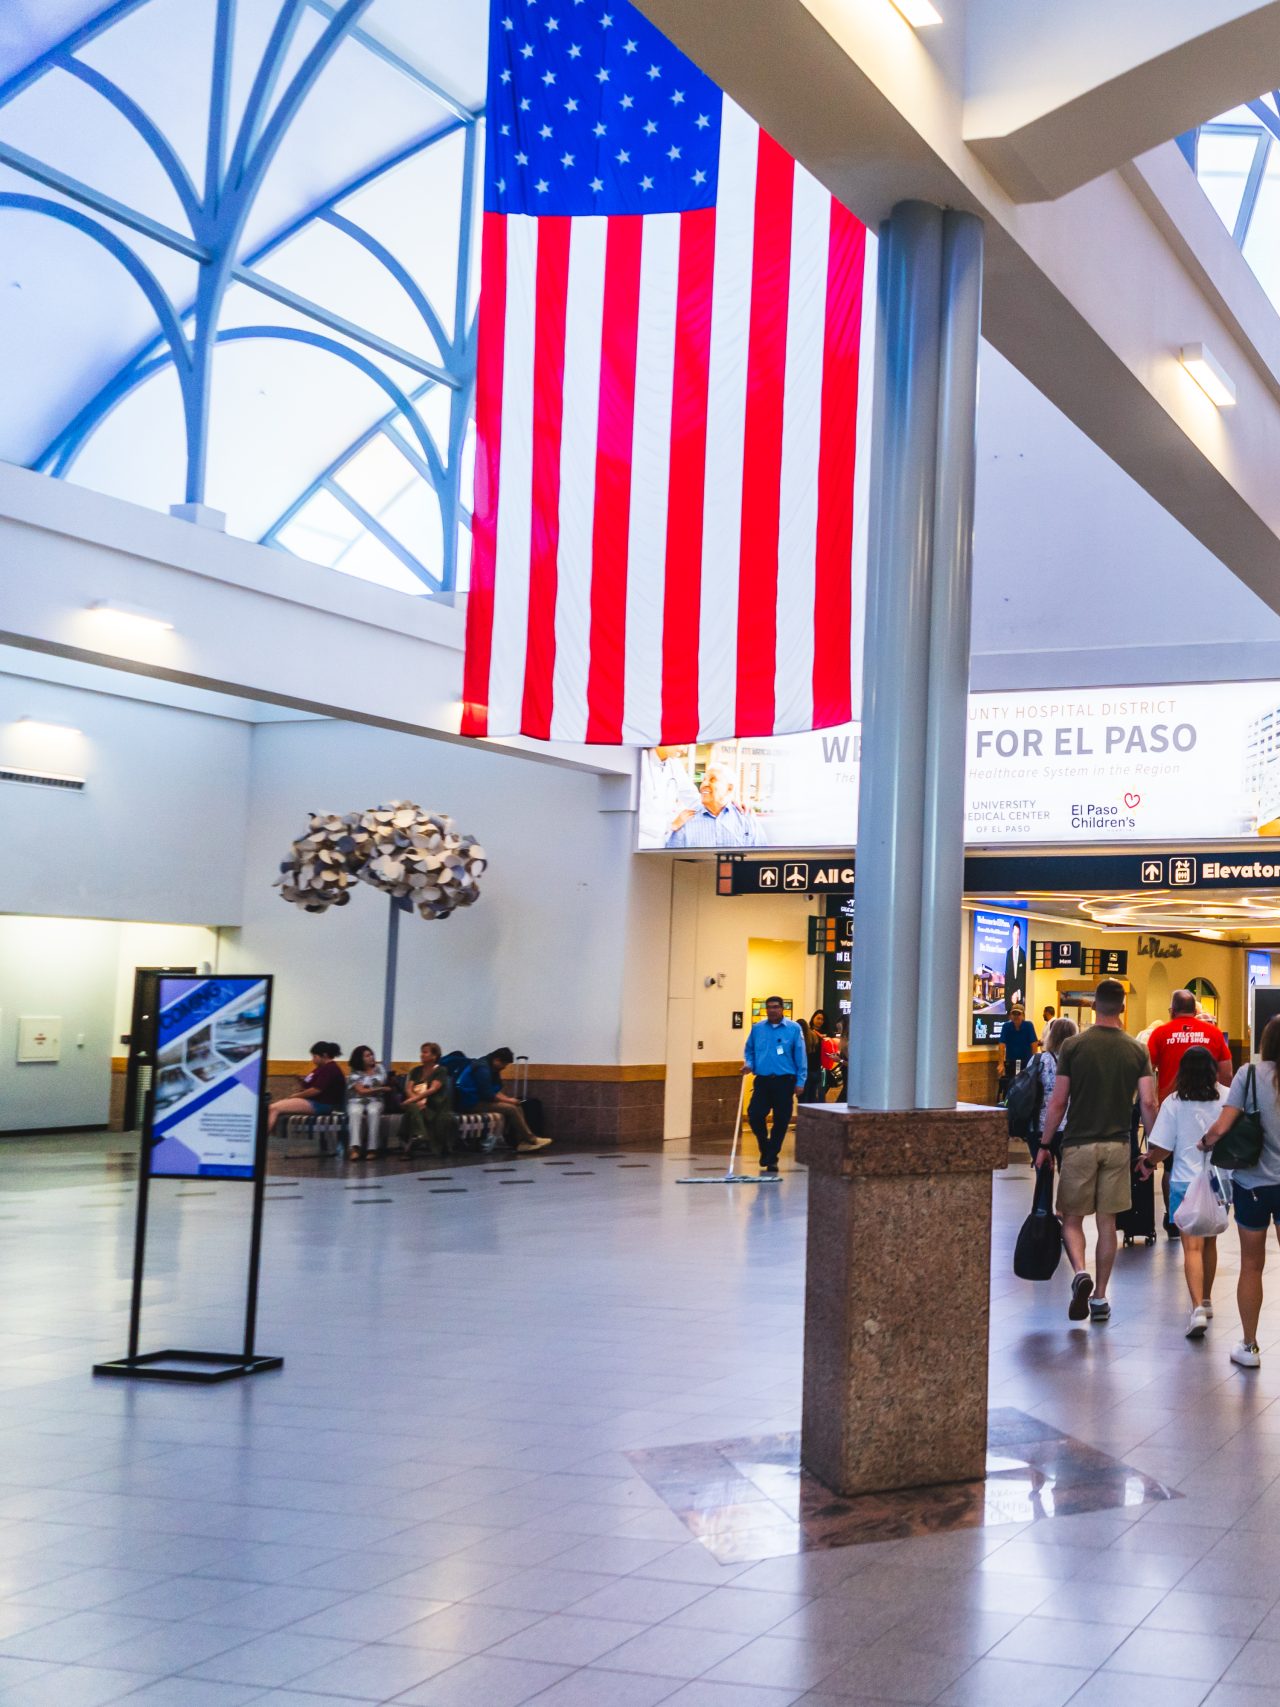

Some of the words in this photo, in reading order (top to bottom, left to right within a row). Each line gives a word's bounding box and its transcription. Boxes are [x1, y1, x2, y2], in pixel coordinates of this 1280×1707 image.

[1015, 703, 1095, 719] HOSPITAL
[1101, 700, 1177, 716] DISTRICT
[976, 729, 1043, 758] FOR
[1055, 727, 1093, 756] EL
[1105, 723, 1197, 754] PASO
[835, 772, 856, 783] The
[968, 766, 1039, 780] Healthcare
[1043, 765, 1089, 780] System
[1093, 764, 1105, 776] in
[1109, 762, 1130, 776] the
[1135, 762, 1181, 777] Region
[972, 799, 1036, 810] UNIVERSITY
[1071, 804, 1083, 816] El
[1087, 804, 1118, 816] Paso
[1008, 810, 1050, 821] CENTER
[992, 825, 1002, 833] EL
[1005, 825, 1031, 833] PASO
[1071, 816, 1136, 829] Children's
[814, 868, 839, 884] All
